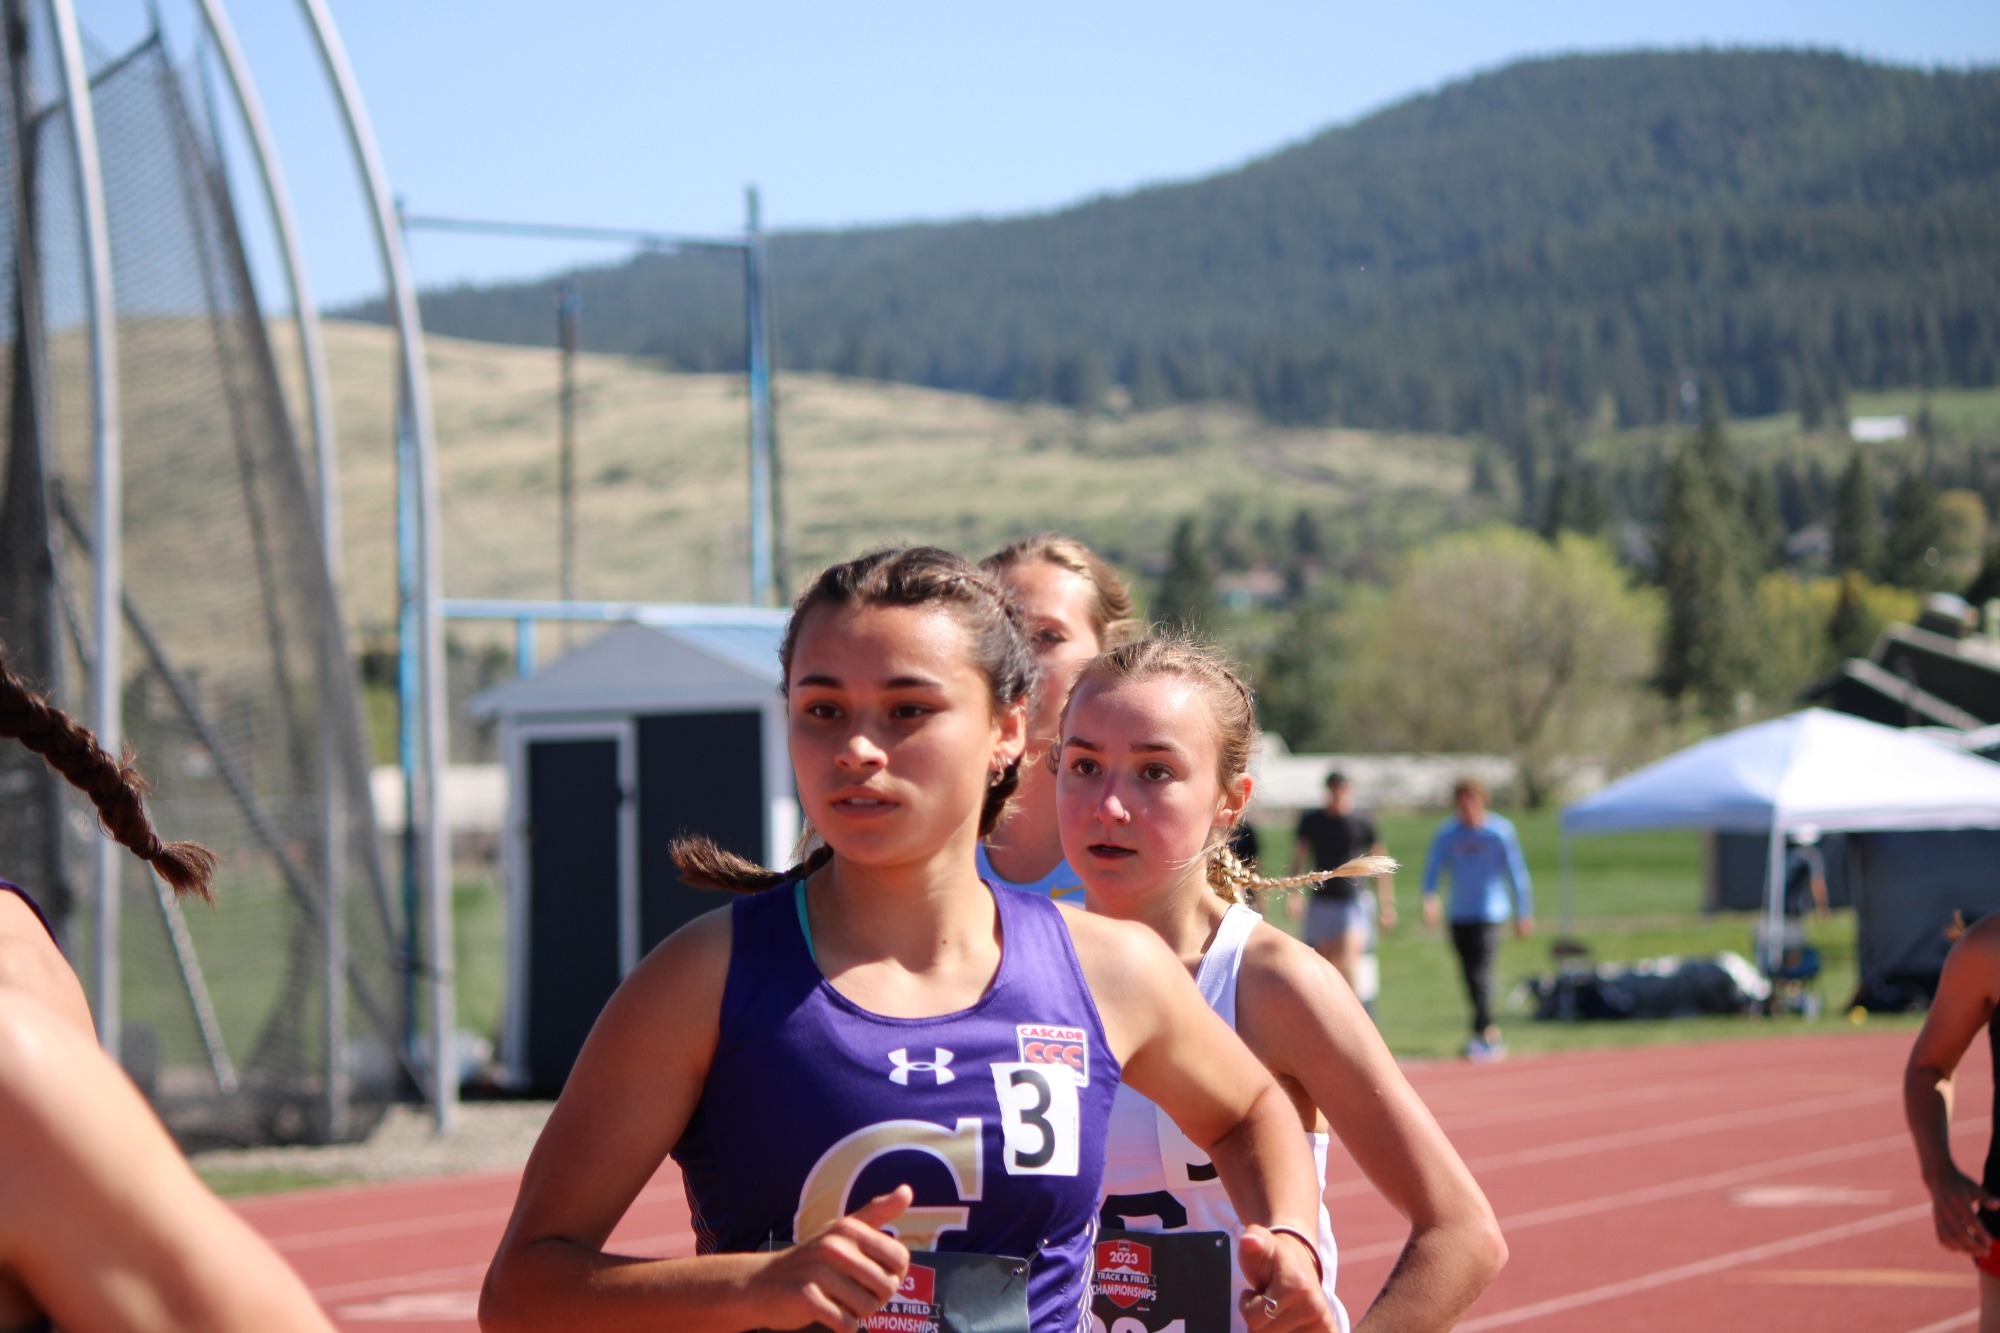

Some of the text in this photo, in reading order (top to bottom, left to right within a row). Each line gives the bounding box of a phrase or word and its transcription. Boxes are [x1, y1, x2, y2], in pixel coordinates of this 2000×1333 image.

[1020, 1027, 1083, 1041] CASCADE
[1025, 1042, 1083, 1068] CCC
[1009, 1069, 1056, 1169] 3
[792, 1118, 983, 1252] G
[1109, 1251, 1138, 1265] 2023
[1097, 1272, 1150, 1284] TRACK & FIELD
[1092, 1284, 1157, 1301] CHAMPIONSHIPS
[890, 1303, 899, 1313] &
[902, 1304, 931, 1315] FIELD
[857, 1316, 939, 1333] AMPIONSHIPS
